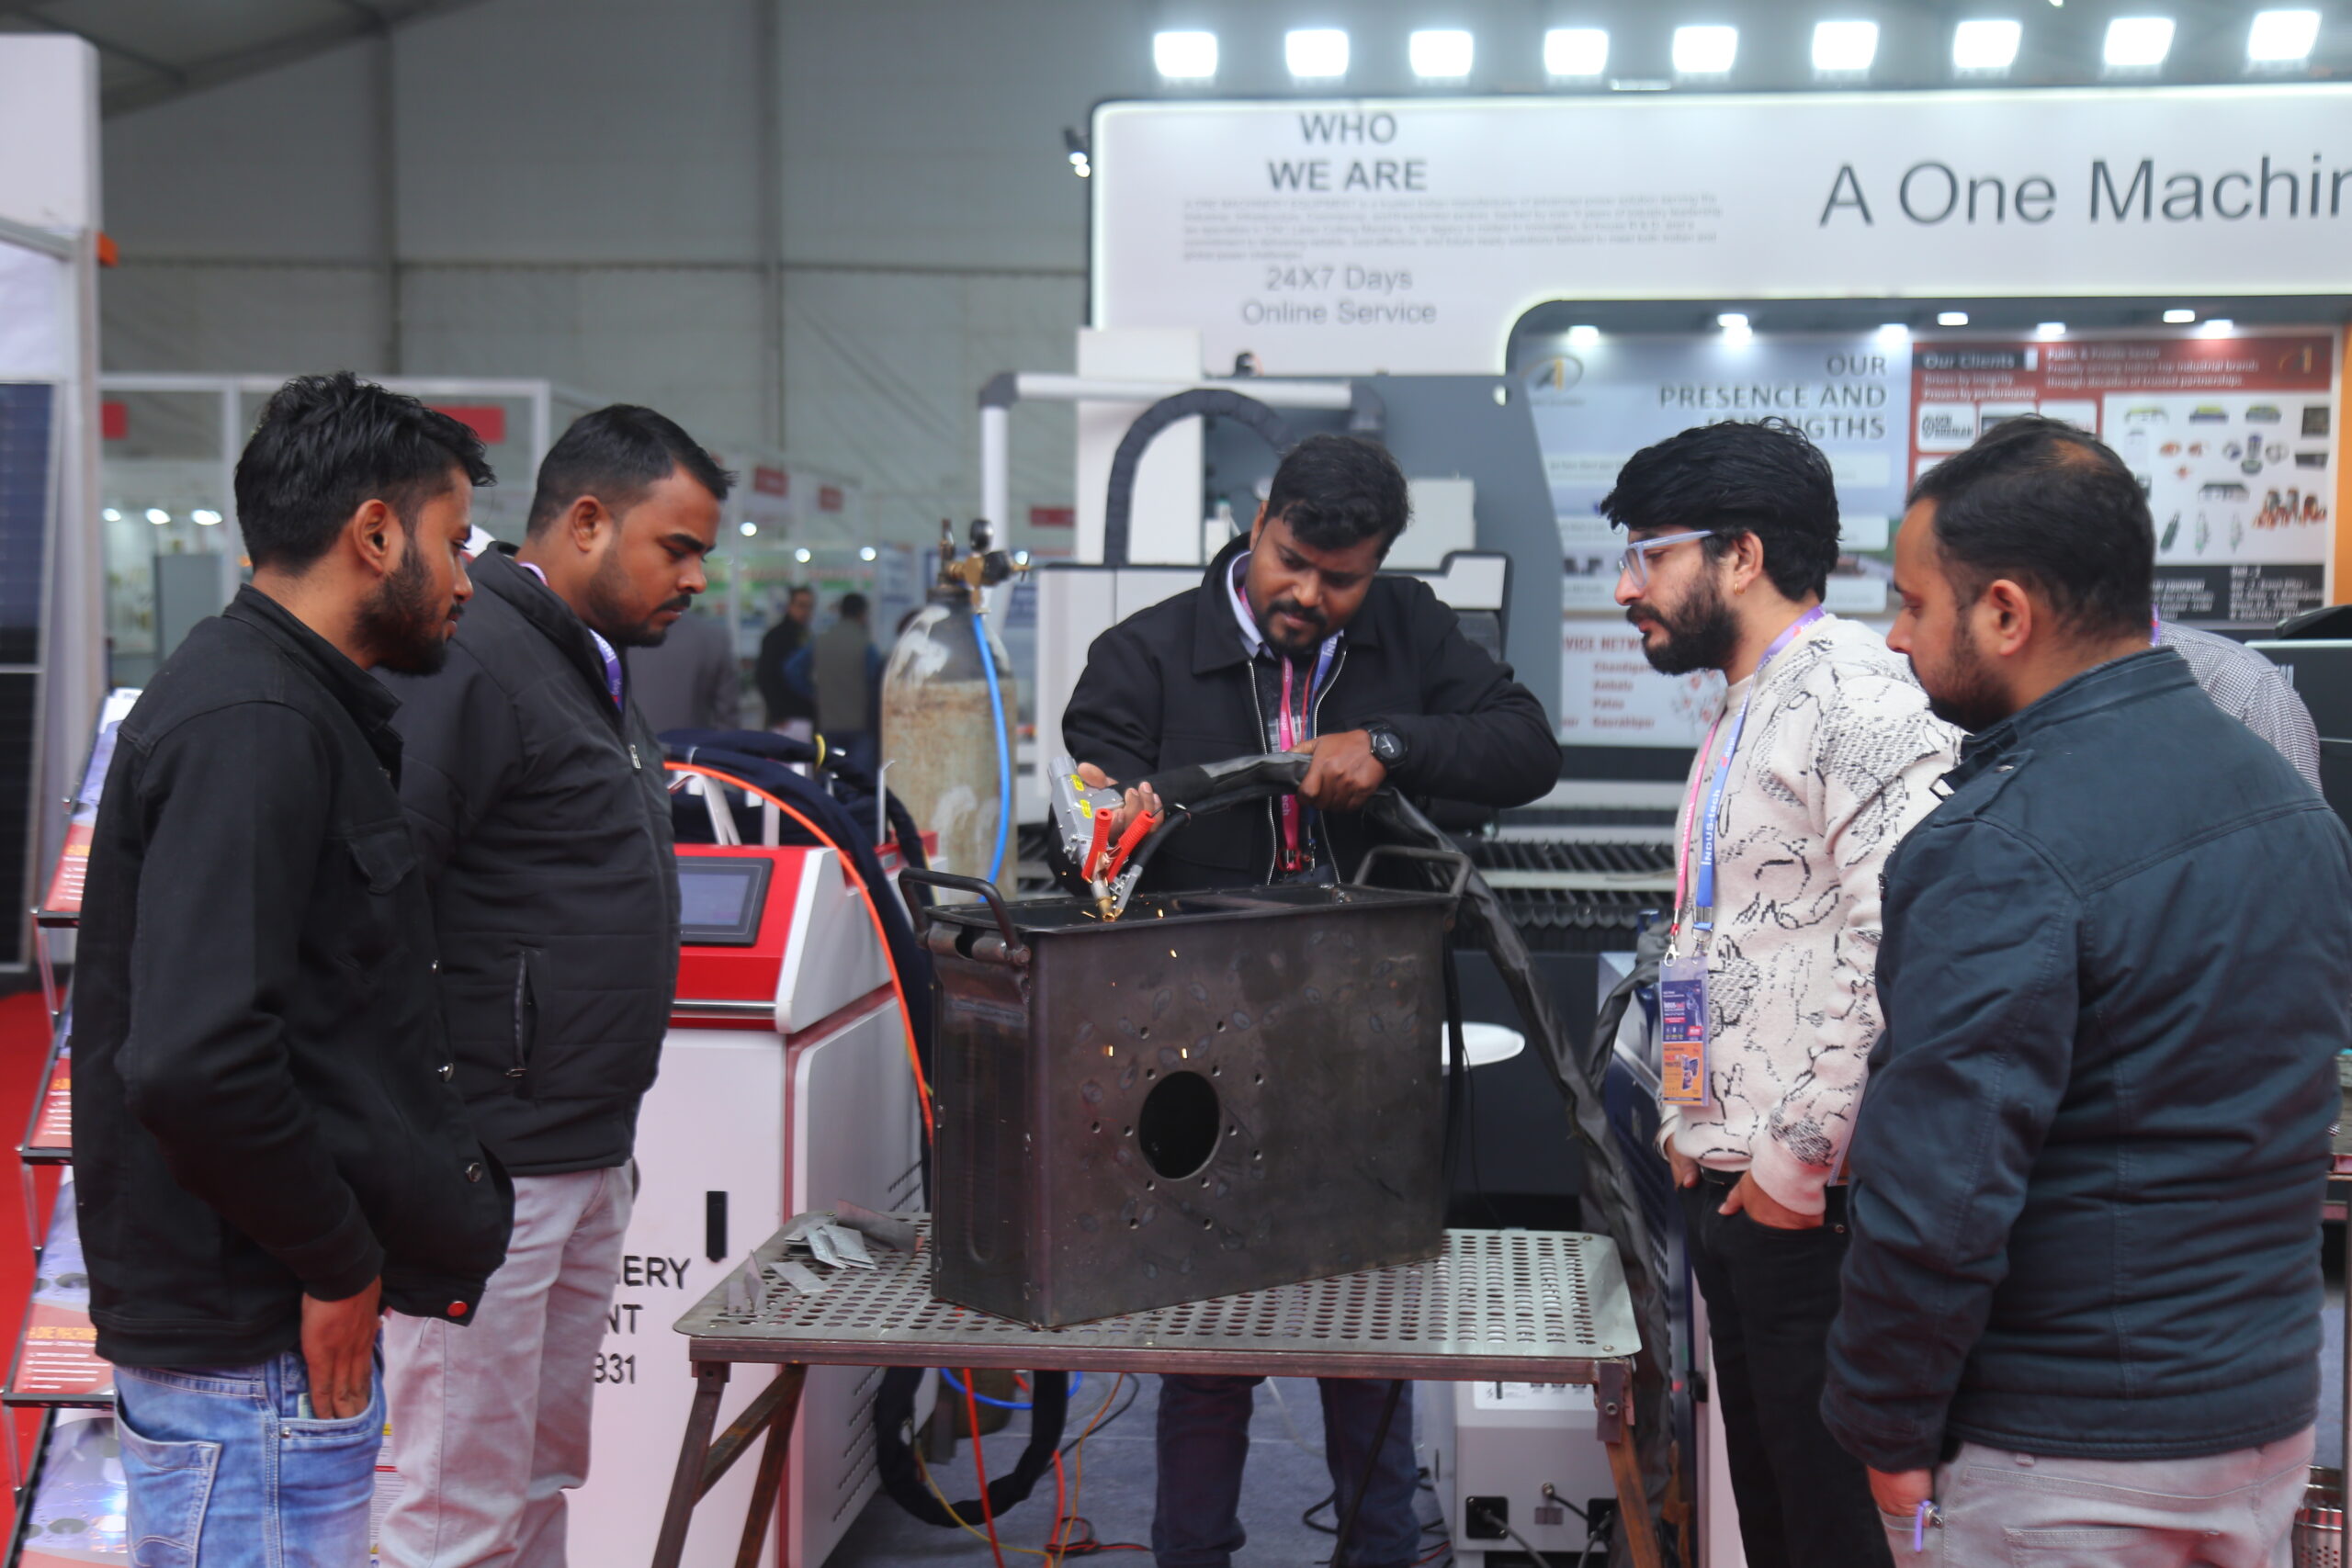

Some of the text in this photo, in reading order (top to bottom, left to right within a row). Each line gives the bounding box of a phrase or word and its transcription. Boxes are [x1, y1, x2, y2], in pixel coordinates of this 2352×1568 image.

[1300, 114, 1398, 145] WHO
[1268, 160, 1428, 191] WE ARE
[1819, 164, 1874, 228] A
[1898, 158, 2058, 225] One
[1265, 266, 1413, 296] 24X7 Days
[1242, 299, 1437, 324] Online Service
[1826, 355, 1887, 377] OUR
[1923, 350, 2016, 369] Our Clients
[1660, 383, 1887, 409] PRESENCE AND
[623, 1256, 691, 1289] ERY
